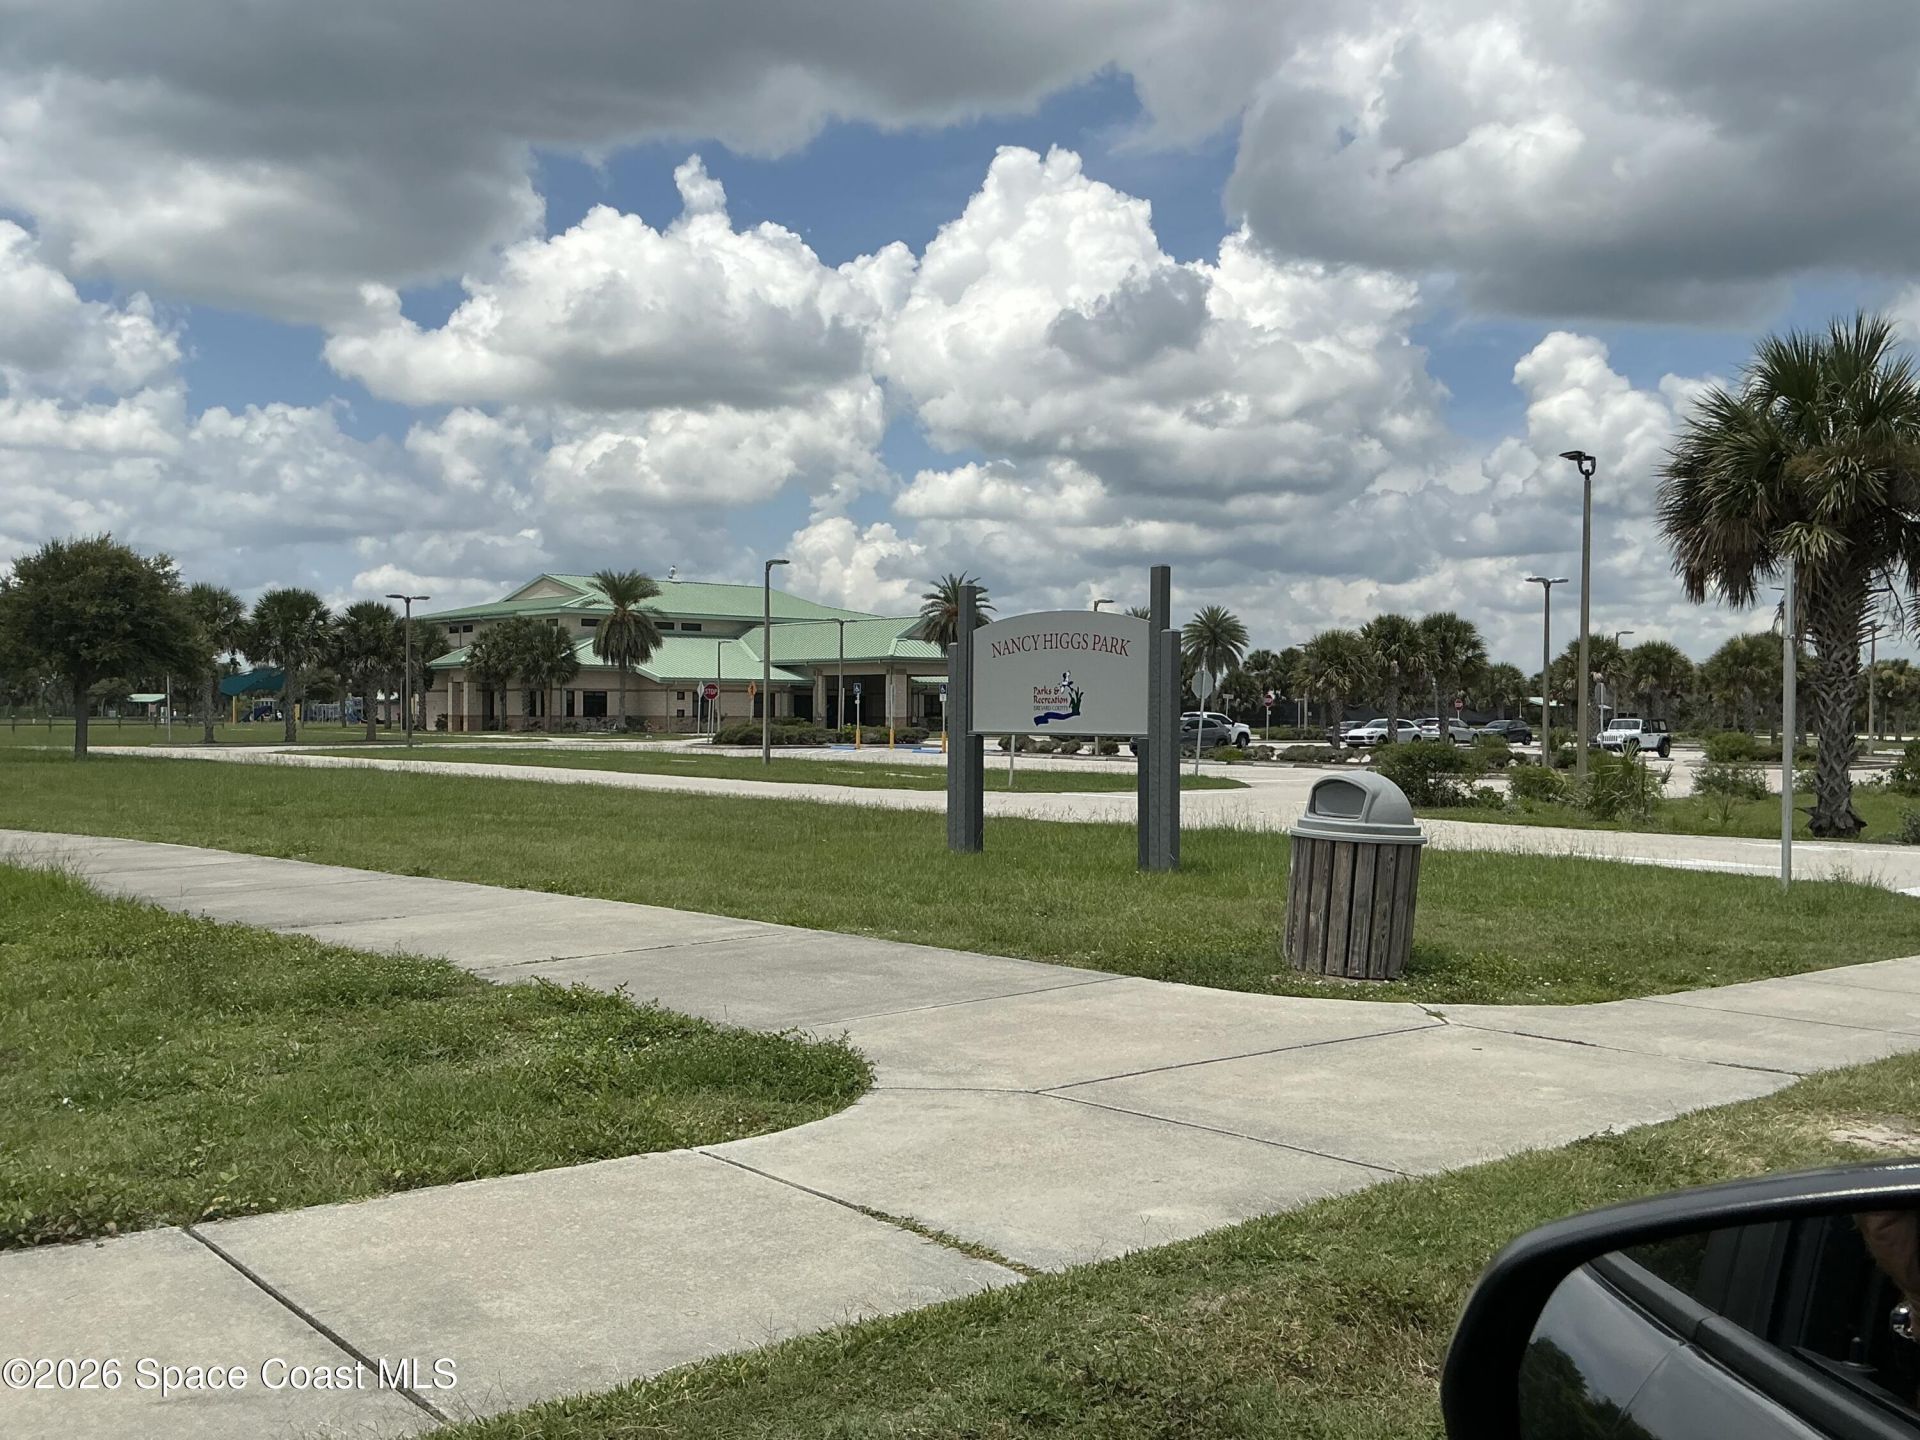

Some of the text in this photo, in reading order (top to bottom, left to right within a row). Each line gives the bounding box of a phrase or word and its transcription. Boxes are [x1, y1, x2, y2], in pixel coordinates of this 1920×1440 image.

[991, 633, 1132, 658] NANCY HIGGS PARK
[1033, 685, 1060, 695] Parks &
[1033, 695, 1069, 704] Recreation
